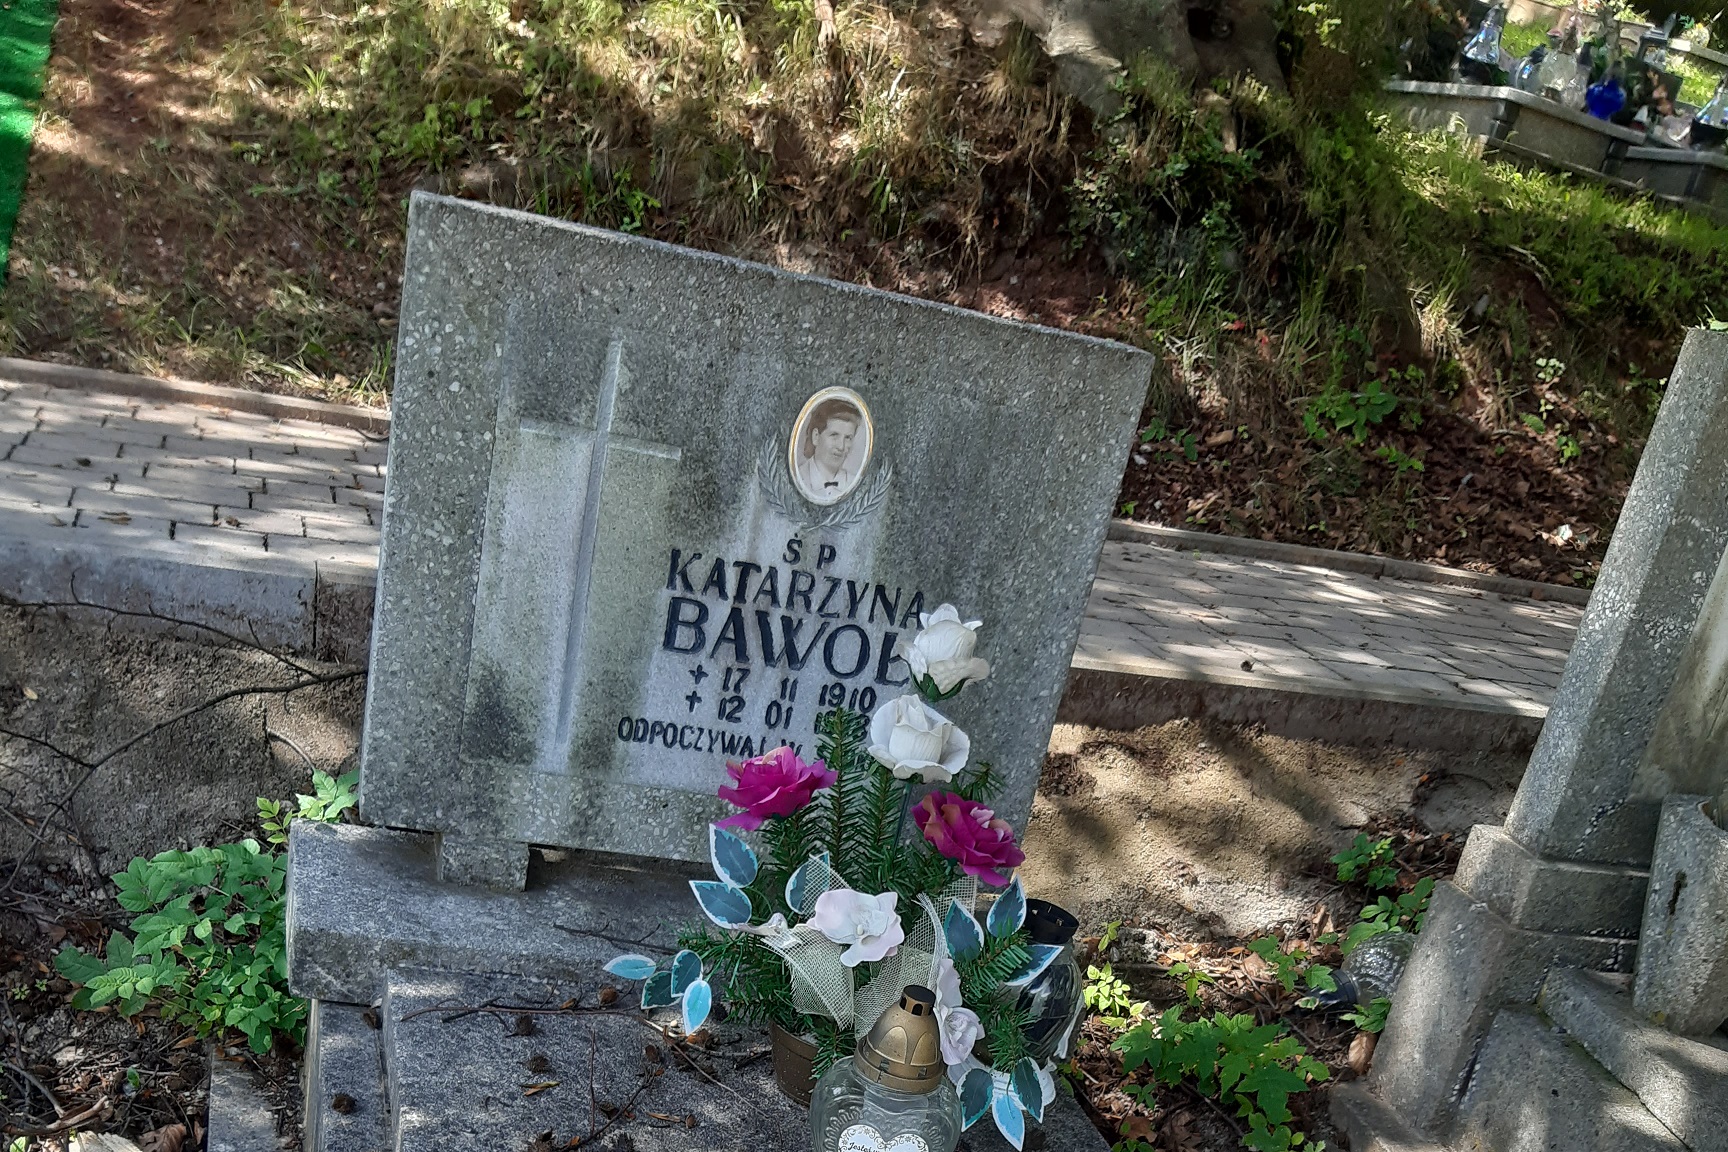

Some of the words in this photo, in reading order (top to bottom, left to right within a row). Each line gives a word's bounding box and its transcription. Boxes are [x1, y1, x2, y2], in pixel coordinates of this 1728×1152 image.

[783, 533, 803, 564] Ś
[816, 544, 837, 570] P
[666, 548, 925, 630] KATARZYNA
[662, 596, 911, 687] BAWOŁ
[717, 695, 746, 724] 12
[765, 700, 793, 730] 01
[722, 667, 751, 694] 17
[780, 677, 799, 702] 11
[818, 682, 877, 714] 1910
[617, 716, 767, 757] ODPOCZYWAJ
